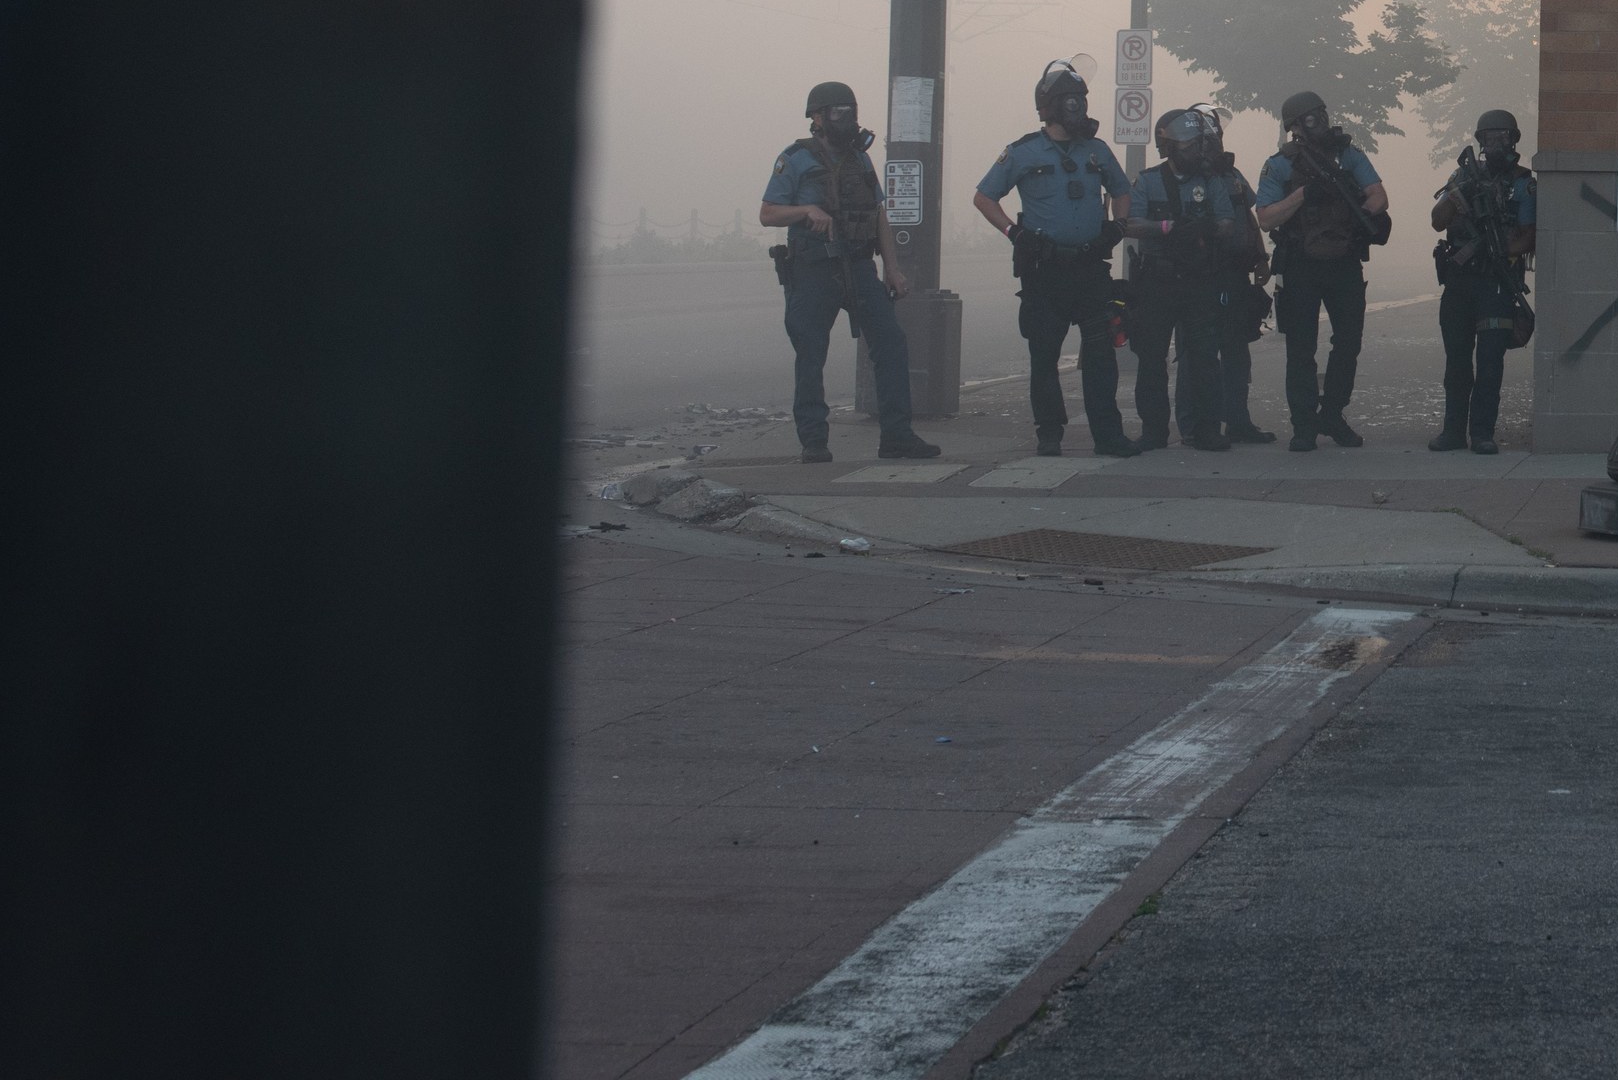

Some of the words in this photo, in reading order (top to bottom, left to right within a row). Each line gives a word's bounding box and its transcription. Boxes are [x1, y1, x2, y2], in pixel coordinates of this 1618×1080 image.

[1121, 62, 1147, 71] CORNER
[1130, 72, 1147, 81] HERE
[1116, 126, 1149, 137] 2AM-6PM
